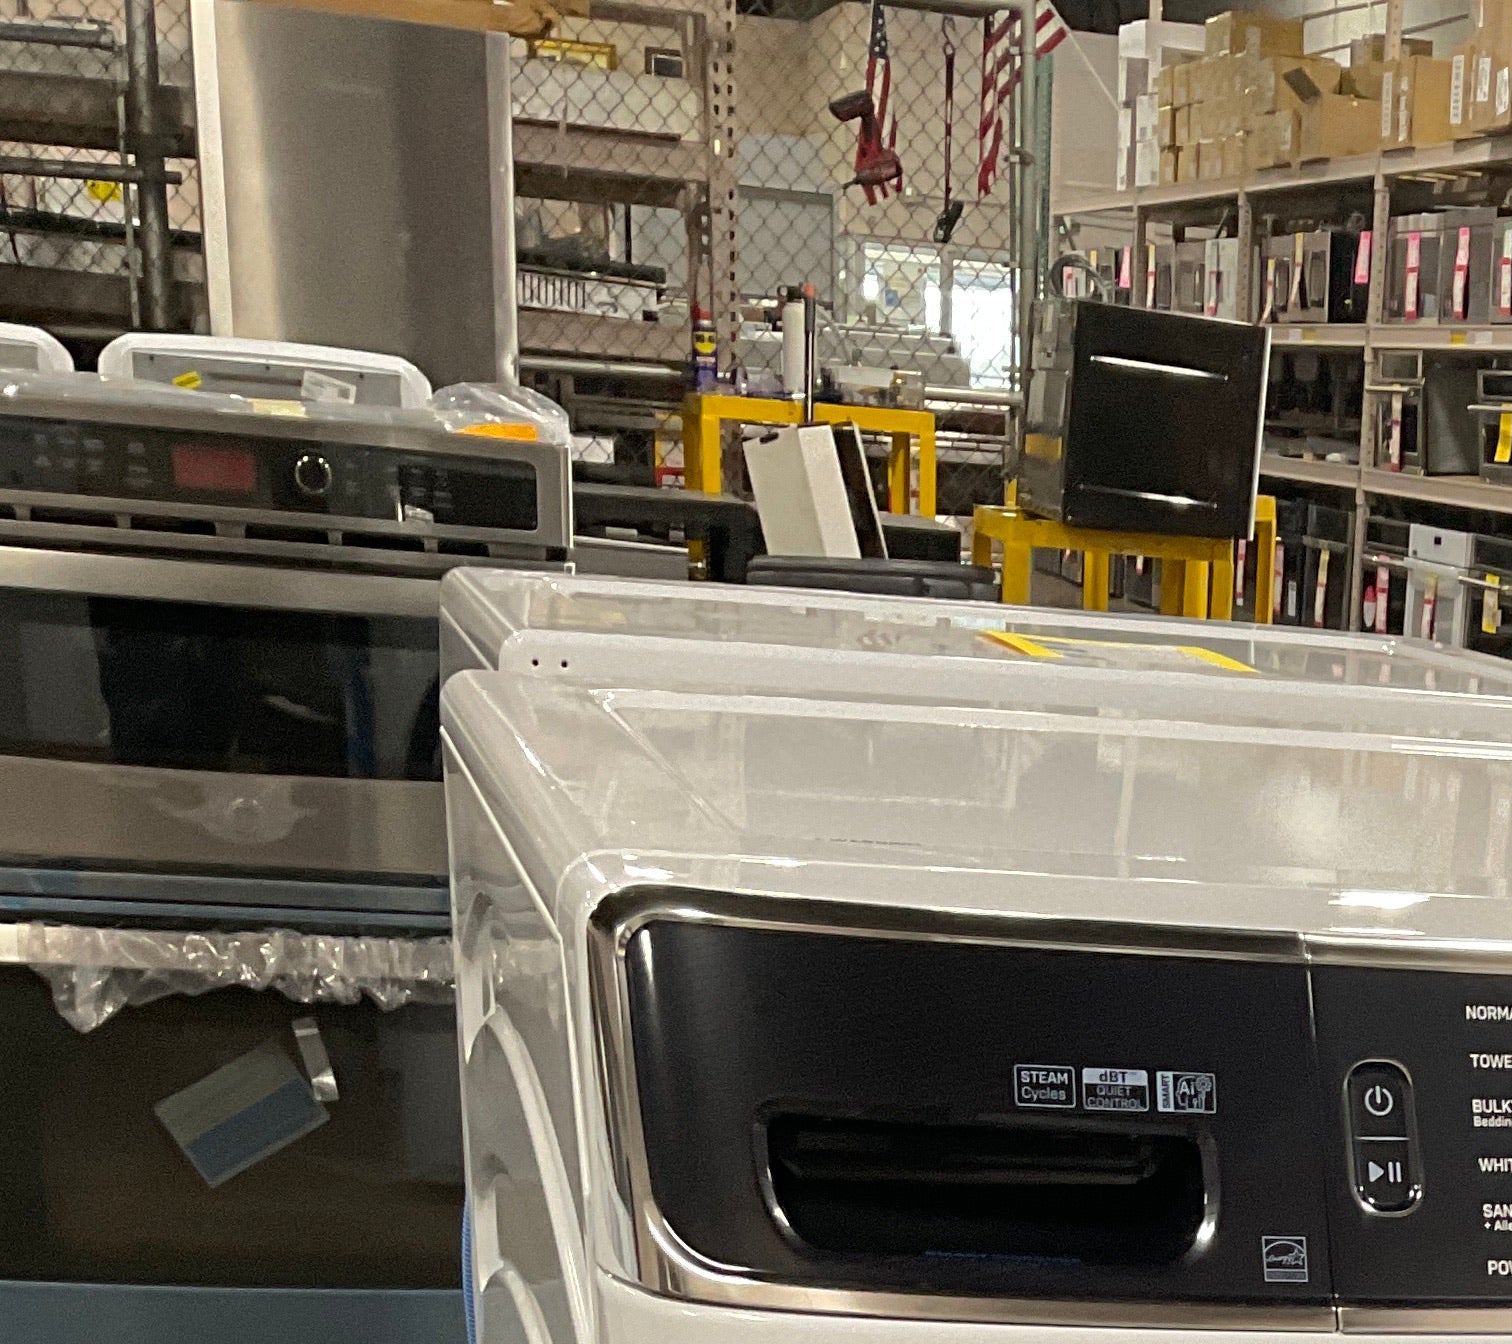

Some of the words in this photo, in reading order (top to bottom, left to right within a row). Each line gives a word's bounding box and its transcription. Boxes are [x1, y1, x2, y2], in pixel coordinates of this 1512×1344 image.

[1020, 1070, 1069, 1085] STEAM
[1021, 1086, 1066, 1101] Cycles
[1096, 1085, 1132, 1097] QUIET
[1087, 1096, 1145, 1109] CONTROL
